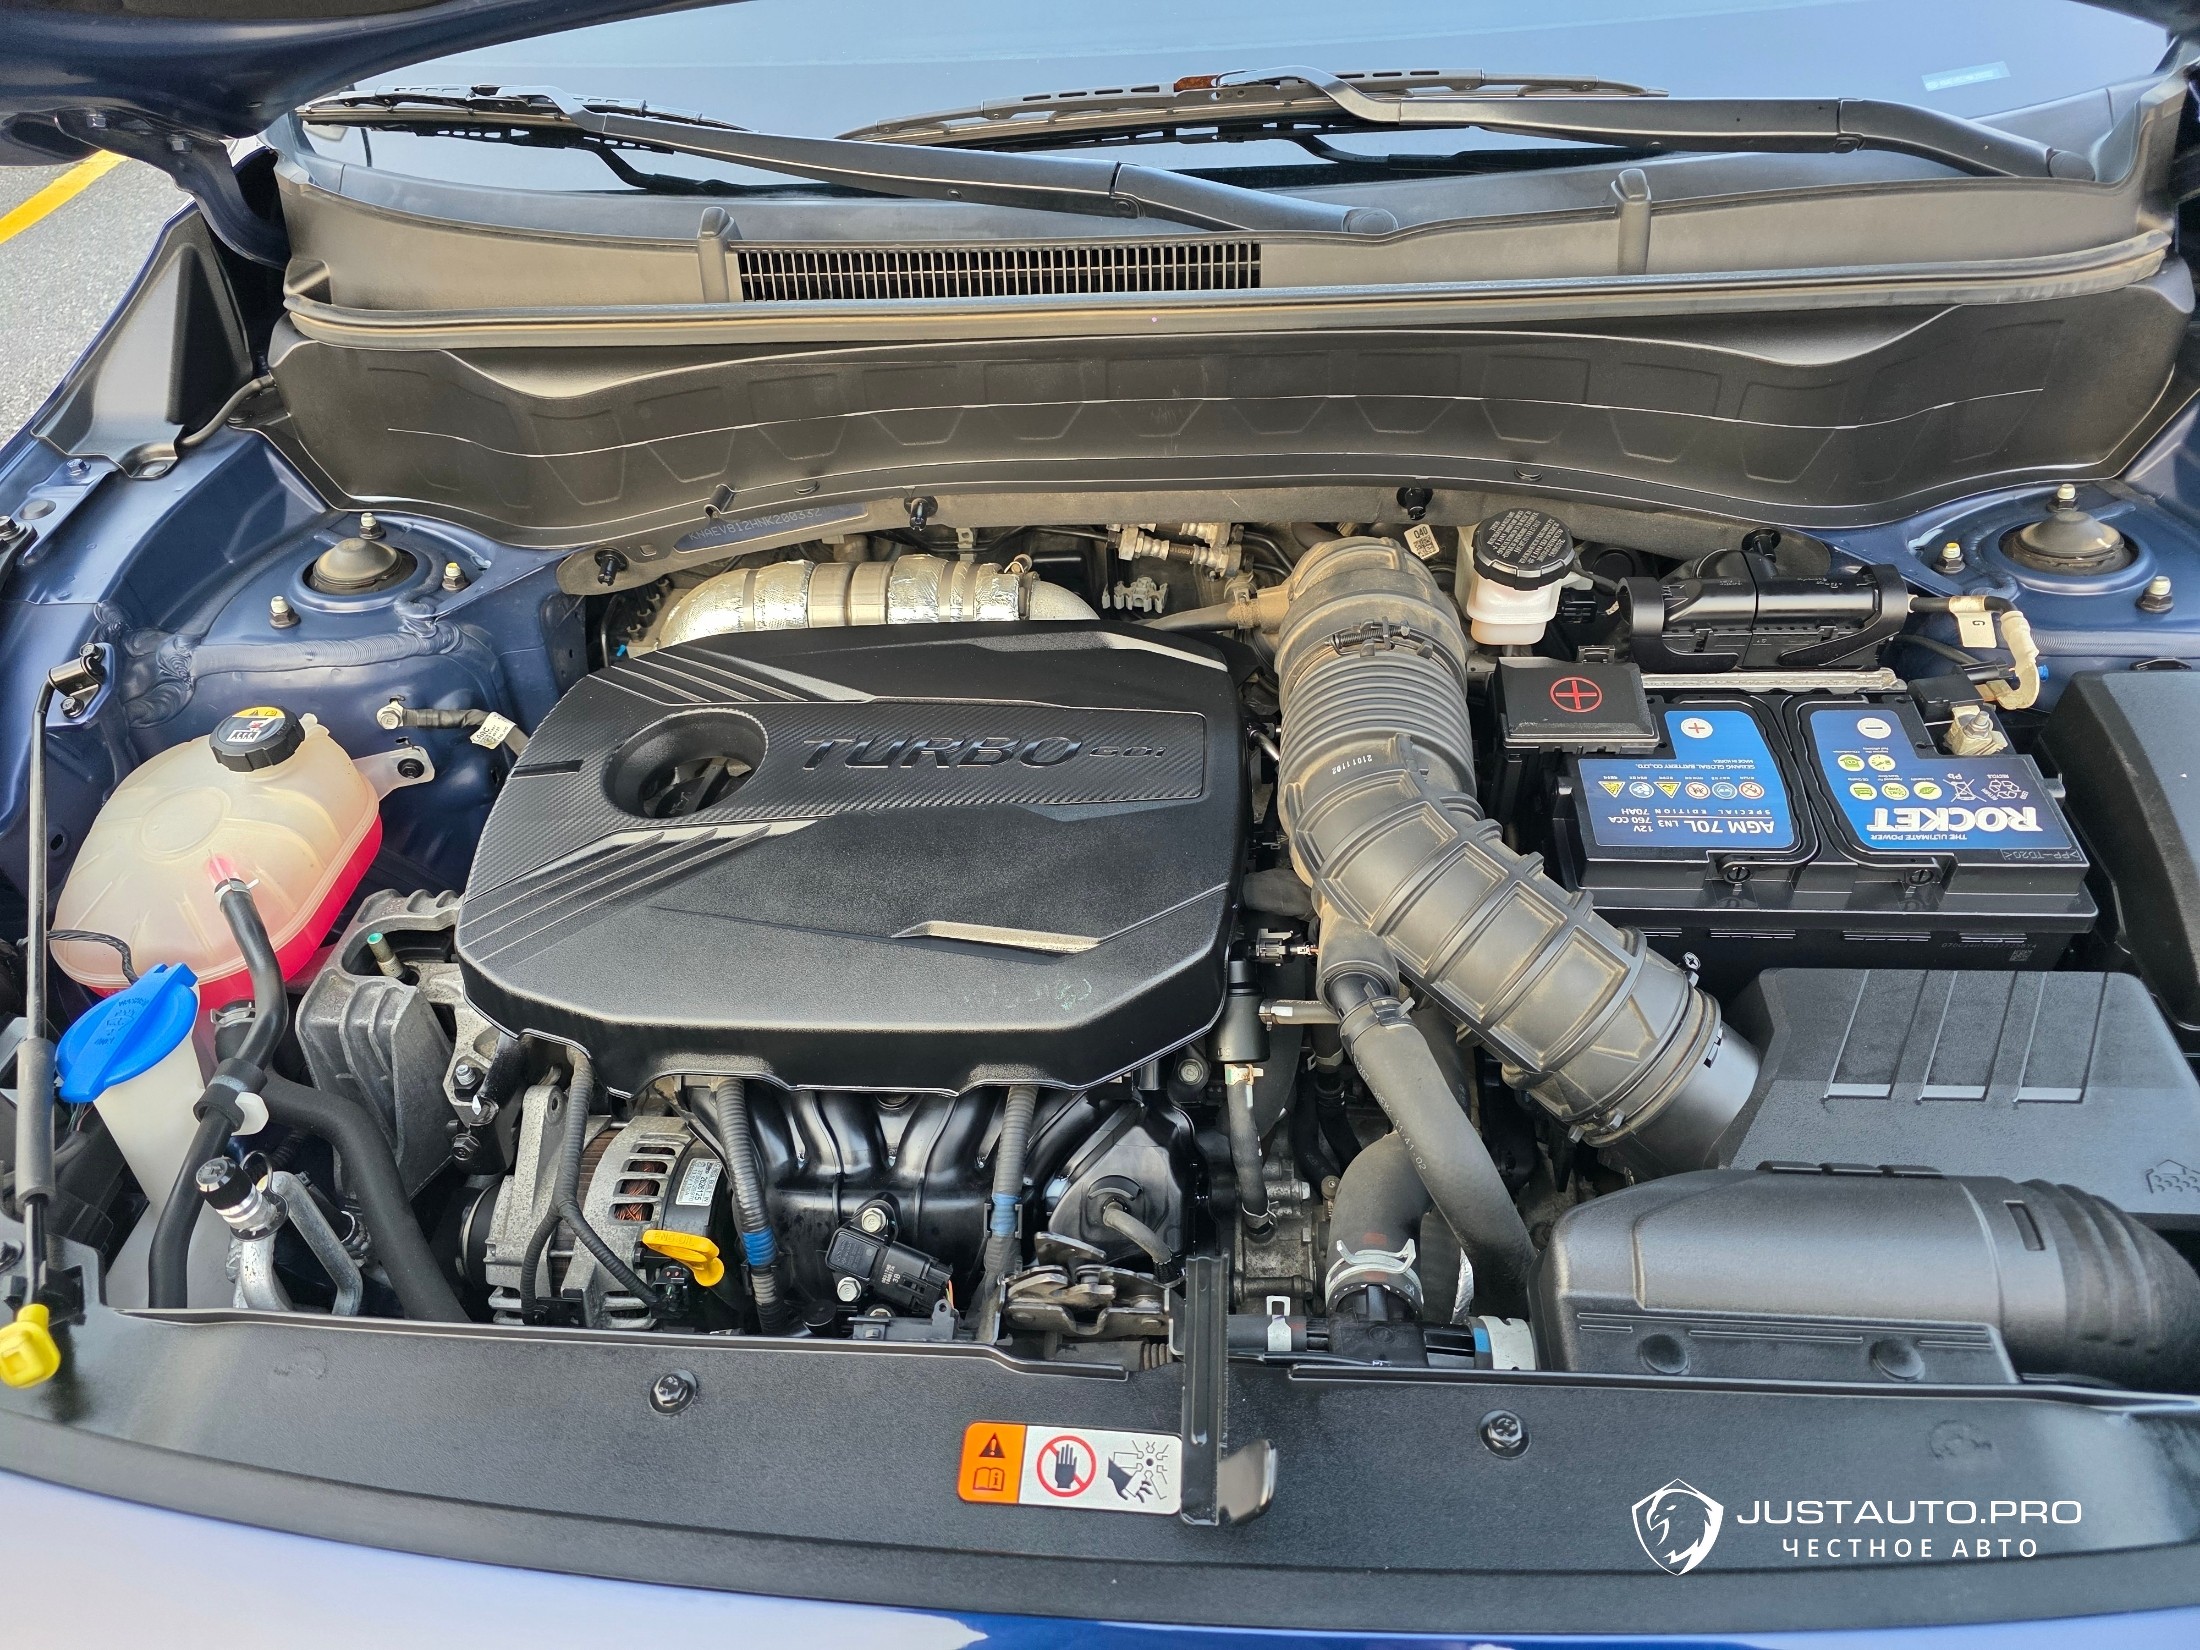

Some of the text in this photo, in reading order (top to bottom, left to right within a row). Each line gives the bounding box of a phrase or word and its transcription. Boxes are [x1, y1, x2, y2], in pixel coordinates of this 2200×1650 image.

[803, 736, 1082, 770] TURBO
[1621, 808, 1650, 816] 70AH
[1632, 816, 1652, 824] 760
[1867, 807, 2043, 832] ROCKET
[1633, 825, 1653, 833] 12V
[1657, 820, 1774, 834] AGM 70L LN3
